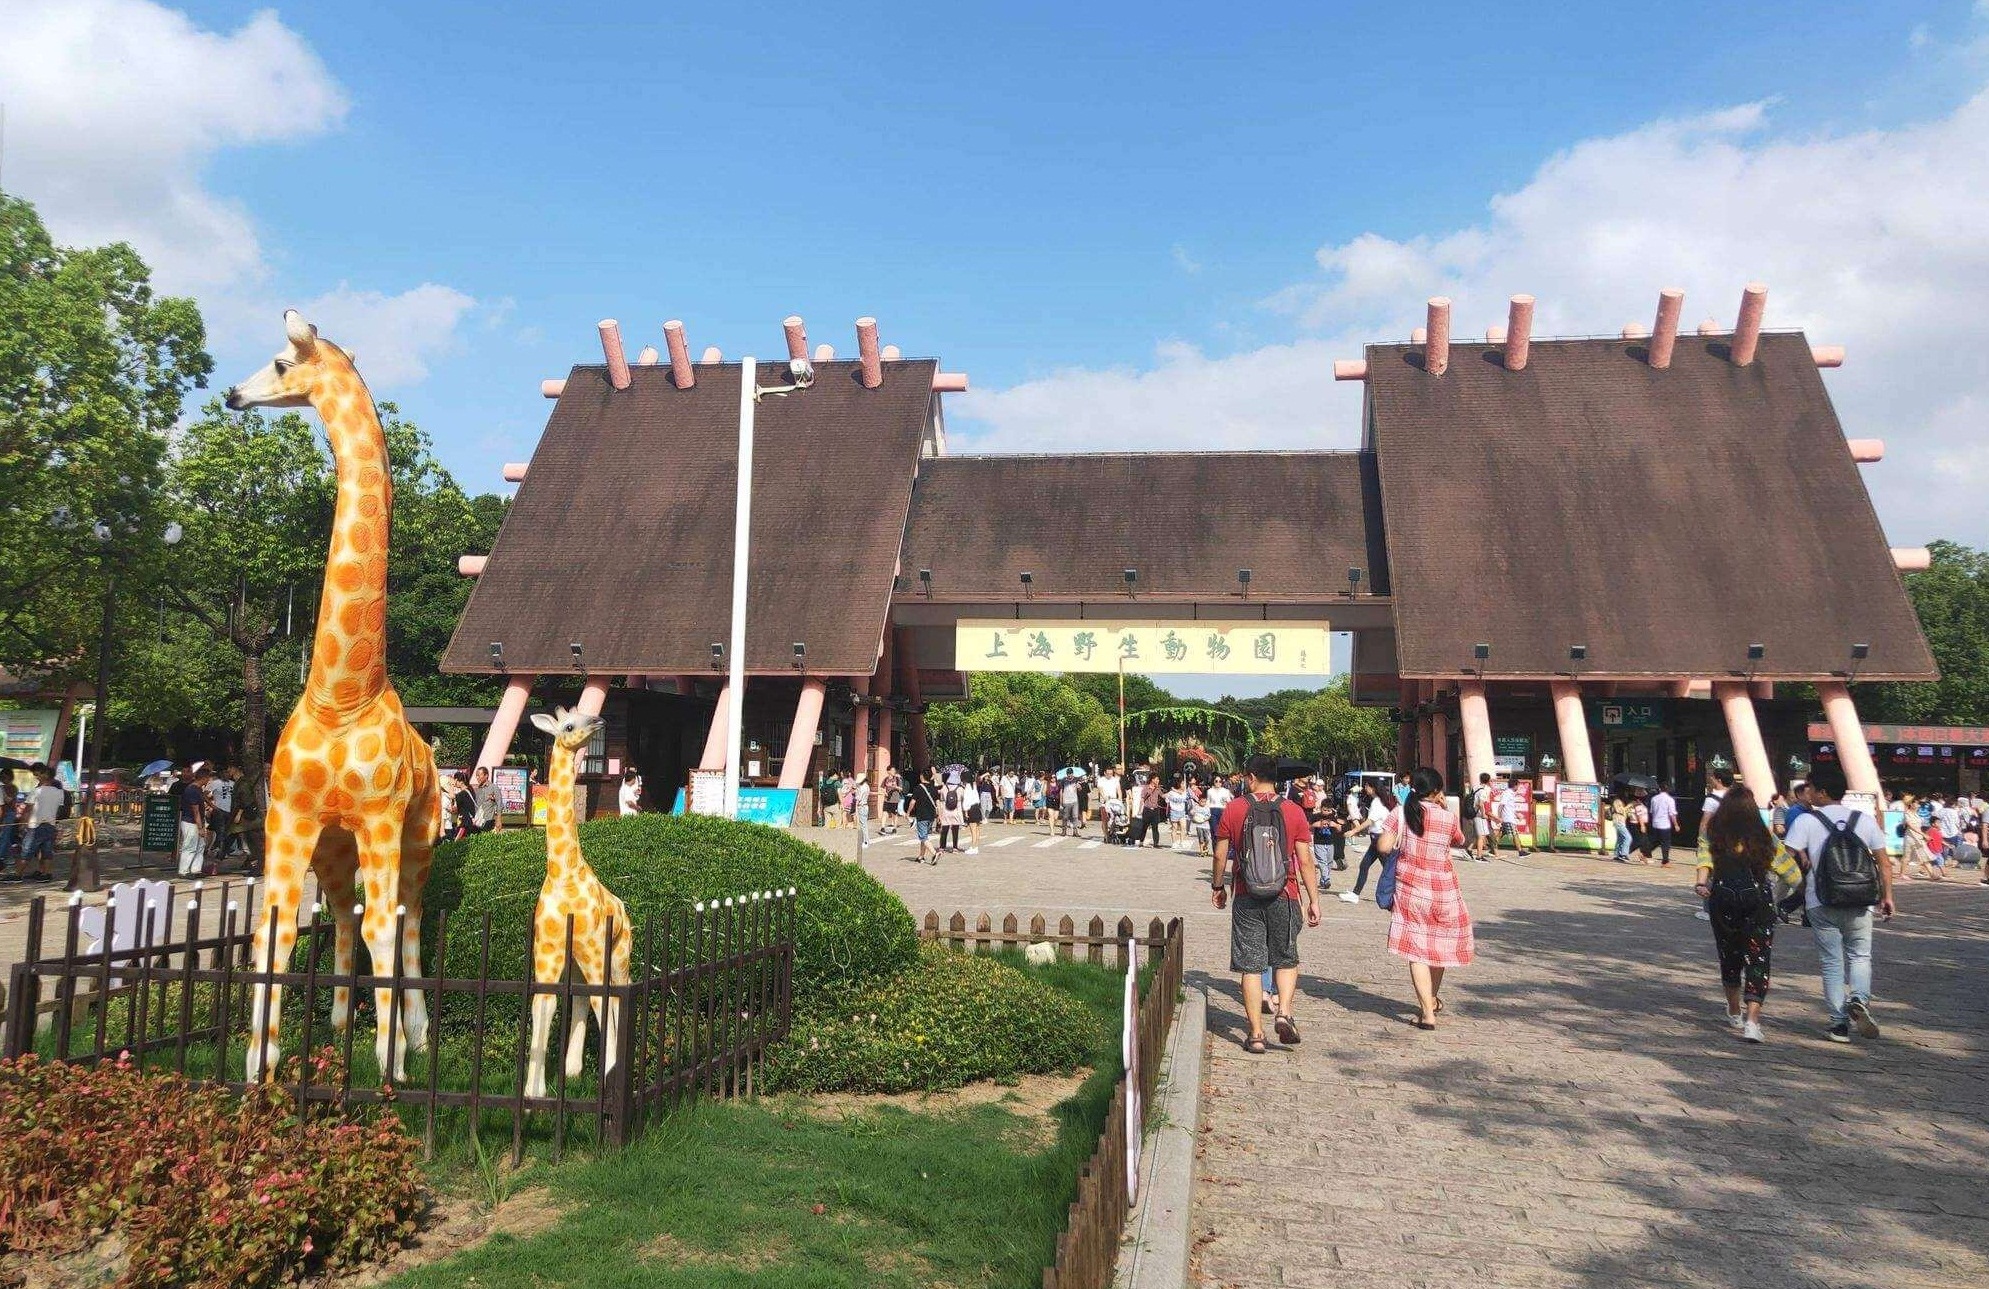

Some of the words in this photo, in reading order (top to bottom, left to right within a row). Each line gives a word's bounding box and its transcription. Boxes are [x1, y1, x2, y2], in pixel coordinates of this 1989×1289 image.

[985, 630, 1277, 662] 上海野生動物園
[1627, 706, 1652, 717] 入口
